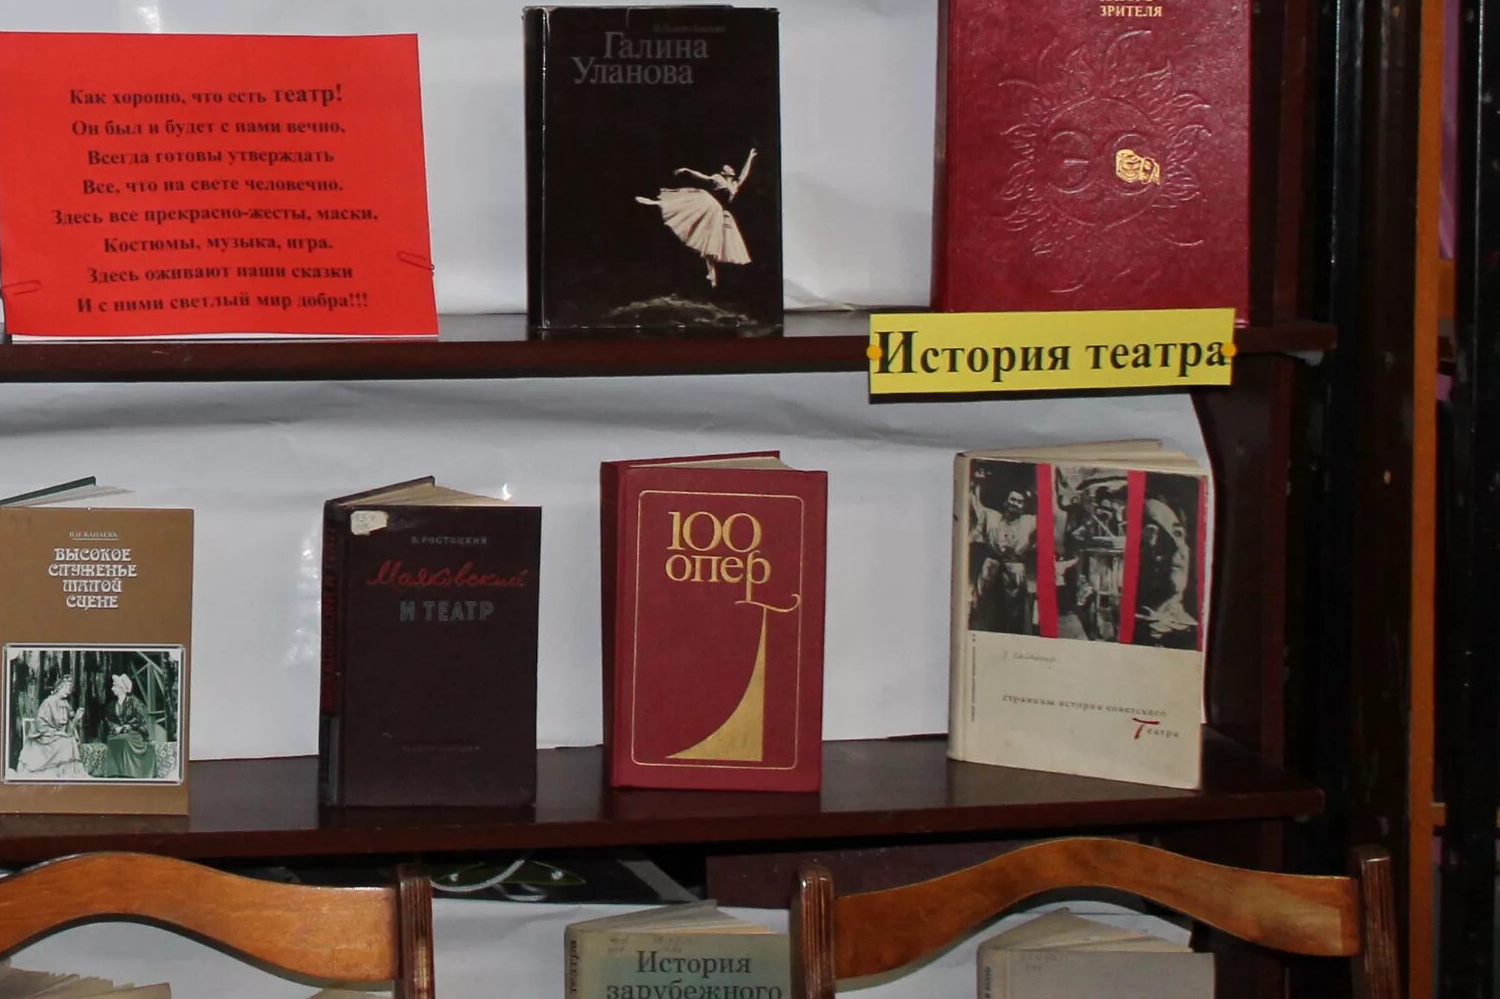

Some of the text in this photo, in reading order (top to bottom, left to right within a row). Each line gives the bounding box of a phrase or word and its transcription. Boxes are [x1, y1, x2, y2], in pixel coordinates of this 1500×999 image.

[1099, 5, 1162, 18] ЗРИТЕЛЯ
[603, 31, 709, 59] Галина
[571, 56, 693, 85] Уланова
[69, 83, 342, 107] Как хорошо, что есть театр!
[72, 120, 99, 135] Он
[105, 120, 142, 135] был
[149, 124, 159, 134] и
[165, 120, 214, 137] будет
[221, 122, 229, 133] с
[235, 122, 281, 133] нами
[88, 150, 334, 166] Всегда готовы утверждать
[83, 179, 343, 194] Все, что на свете человечно.
[53, 210, 103, 225] Здесь
[109, 211, 138, 223] все
[144, 208, 311, 225] прекрасно-жесты,
[104, 237, 333, 253] Костюмы, музыка, игра.
[88, 266, 353, 283] Здесь оживают наши сказки
[77, 292, 368, 313] И с ними светлый мир добра!!!
[874, 330, 1227, 383] История театра
[666, 511, 762, 552] 100
[53, 548, 132, 561] ВЫСОКОЕ
[48, 564, 138, 577] СЛУЖЕНЬЕ
[366, 559, 528, 589] Маяковский
[665, 551, 771, 602] опер
[62, 578, 122, 592] МАЛОЙ
[66, 595, 119, 610] СЦЕНЕ
[400, 601, 495, 622] И ТЕАТР
[636, 950, 751, 978] История
[606, 978, 782, 999] зарубежного
